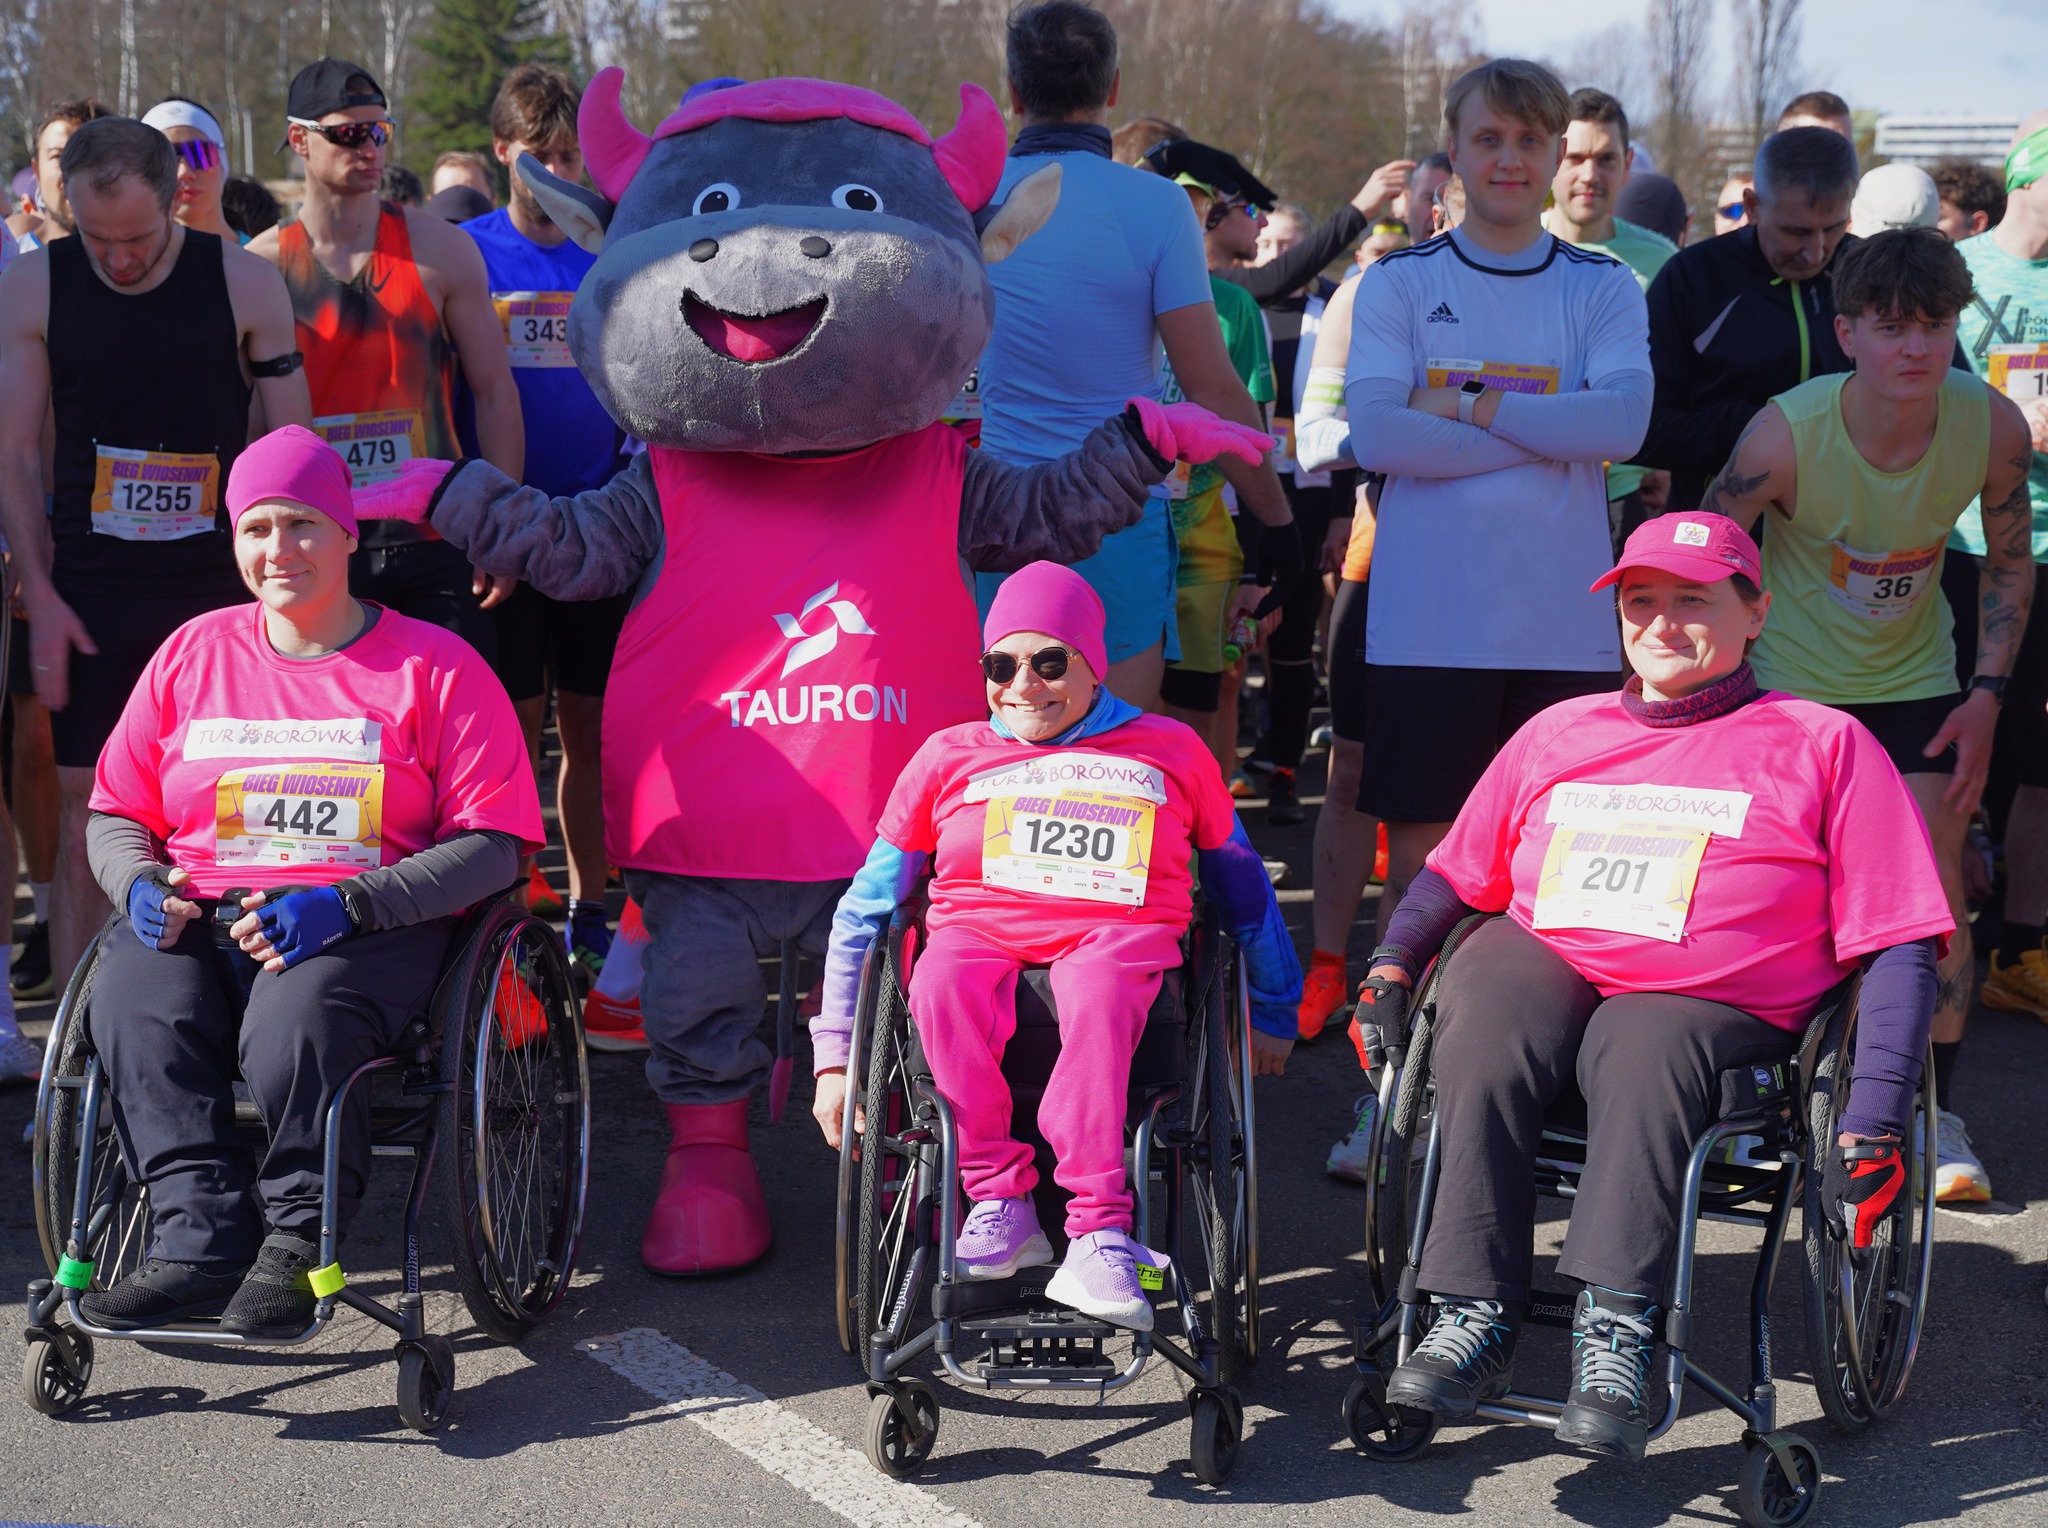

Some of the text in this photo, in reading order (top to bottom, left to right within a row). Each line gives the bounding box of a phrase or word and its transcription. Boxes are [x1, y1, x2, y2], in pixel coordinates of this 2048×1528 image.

[508, 302, 532, 316] BIEG
[1426, 314, 1459, 324] adidas
[1477, 373, 1550, 395] WIOSENNY
[327, 418, 414, 441] BIEG WIOSENNY
[347, 439, 396, 467] 479
[111, 460, 211, 482] BIEG WIOSENNY
[122, 483, 192, 513] 1255
[1849, 559, 1880, 577] BIEG
[1873, 575, 1914, 599] 36
[720, 683, 907, 728] TAURON
[199, 726, 367, 746] TUR BORÓWKA
[242, 773, 372, 798] BIEG WIOSENNY
[980, 774, 1019, 788] TUR
[1050, 762, 1156, 790] BORÓWKA
[264, 798, 339, 836] 442
[1012, 796, 1143, 828] BIEG WIOSENNY
[1564, 792, 1731, 819] TUR BORÓWKA
[1026, 818, 1115, 862] 1230
[1569, 831, 1694, 859] BIEG WIOSENNY
[1581, 857, 1650, 894] 201
